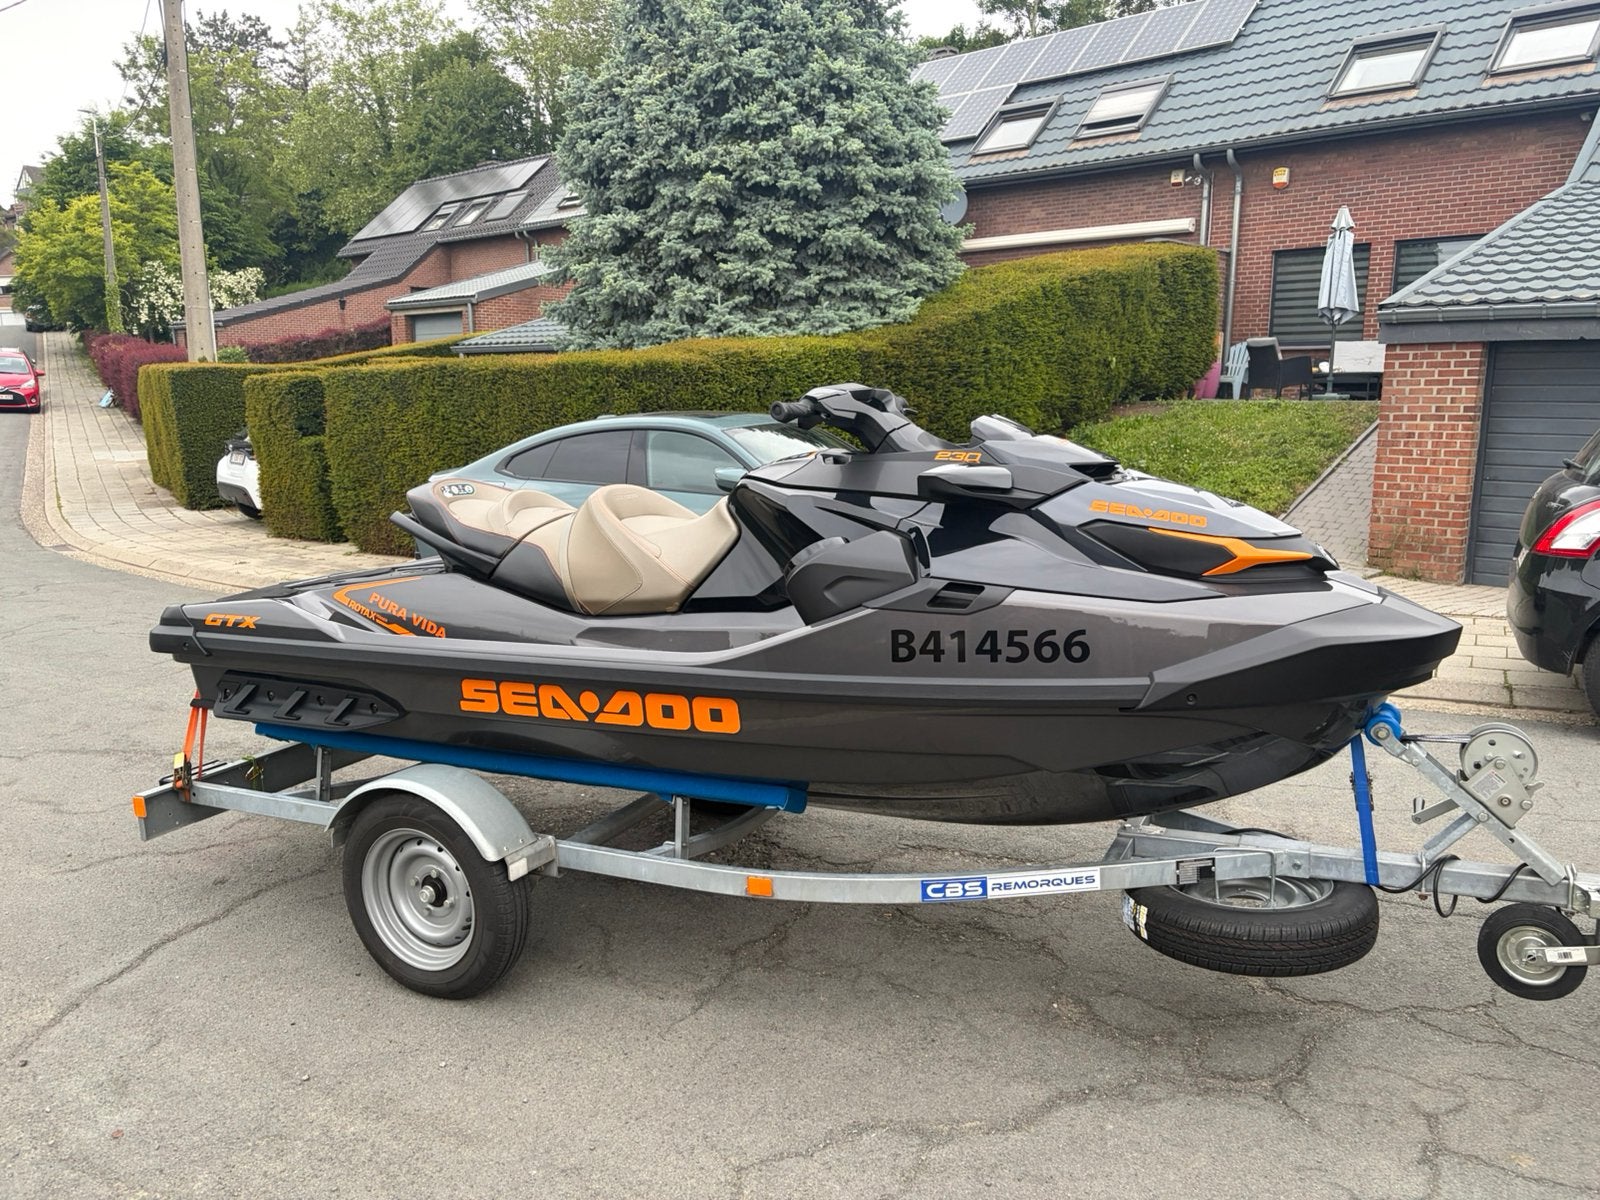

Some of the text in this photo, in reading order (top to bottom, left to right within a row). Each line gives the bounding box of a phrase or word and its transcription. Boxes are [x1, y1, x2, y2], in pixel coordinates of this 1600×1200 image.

[204, 613, 261, 630] GTX
[348, 599, 376, 621] ROTAX
[369, 592, 446, 639] PURA VIDA
[891, 629, 1091, 664] B414566
[926, 875, 1096, 899] CBS REMORQUES
